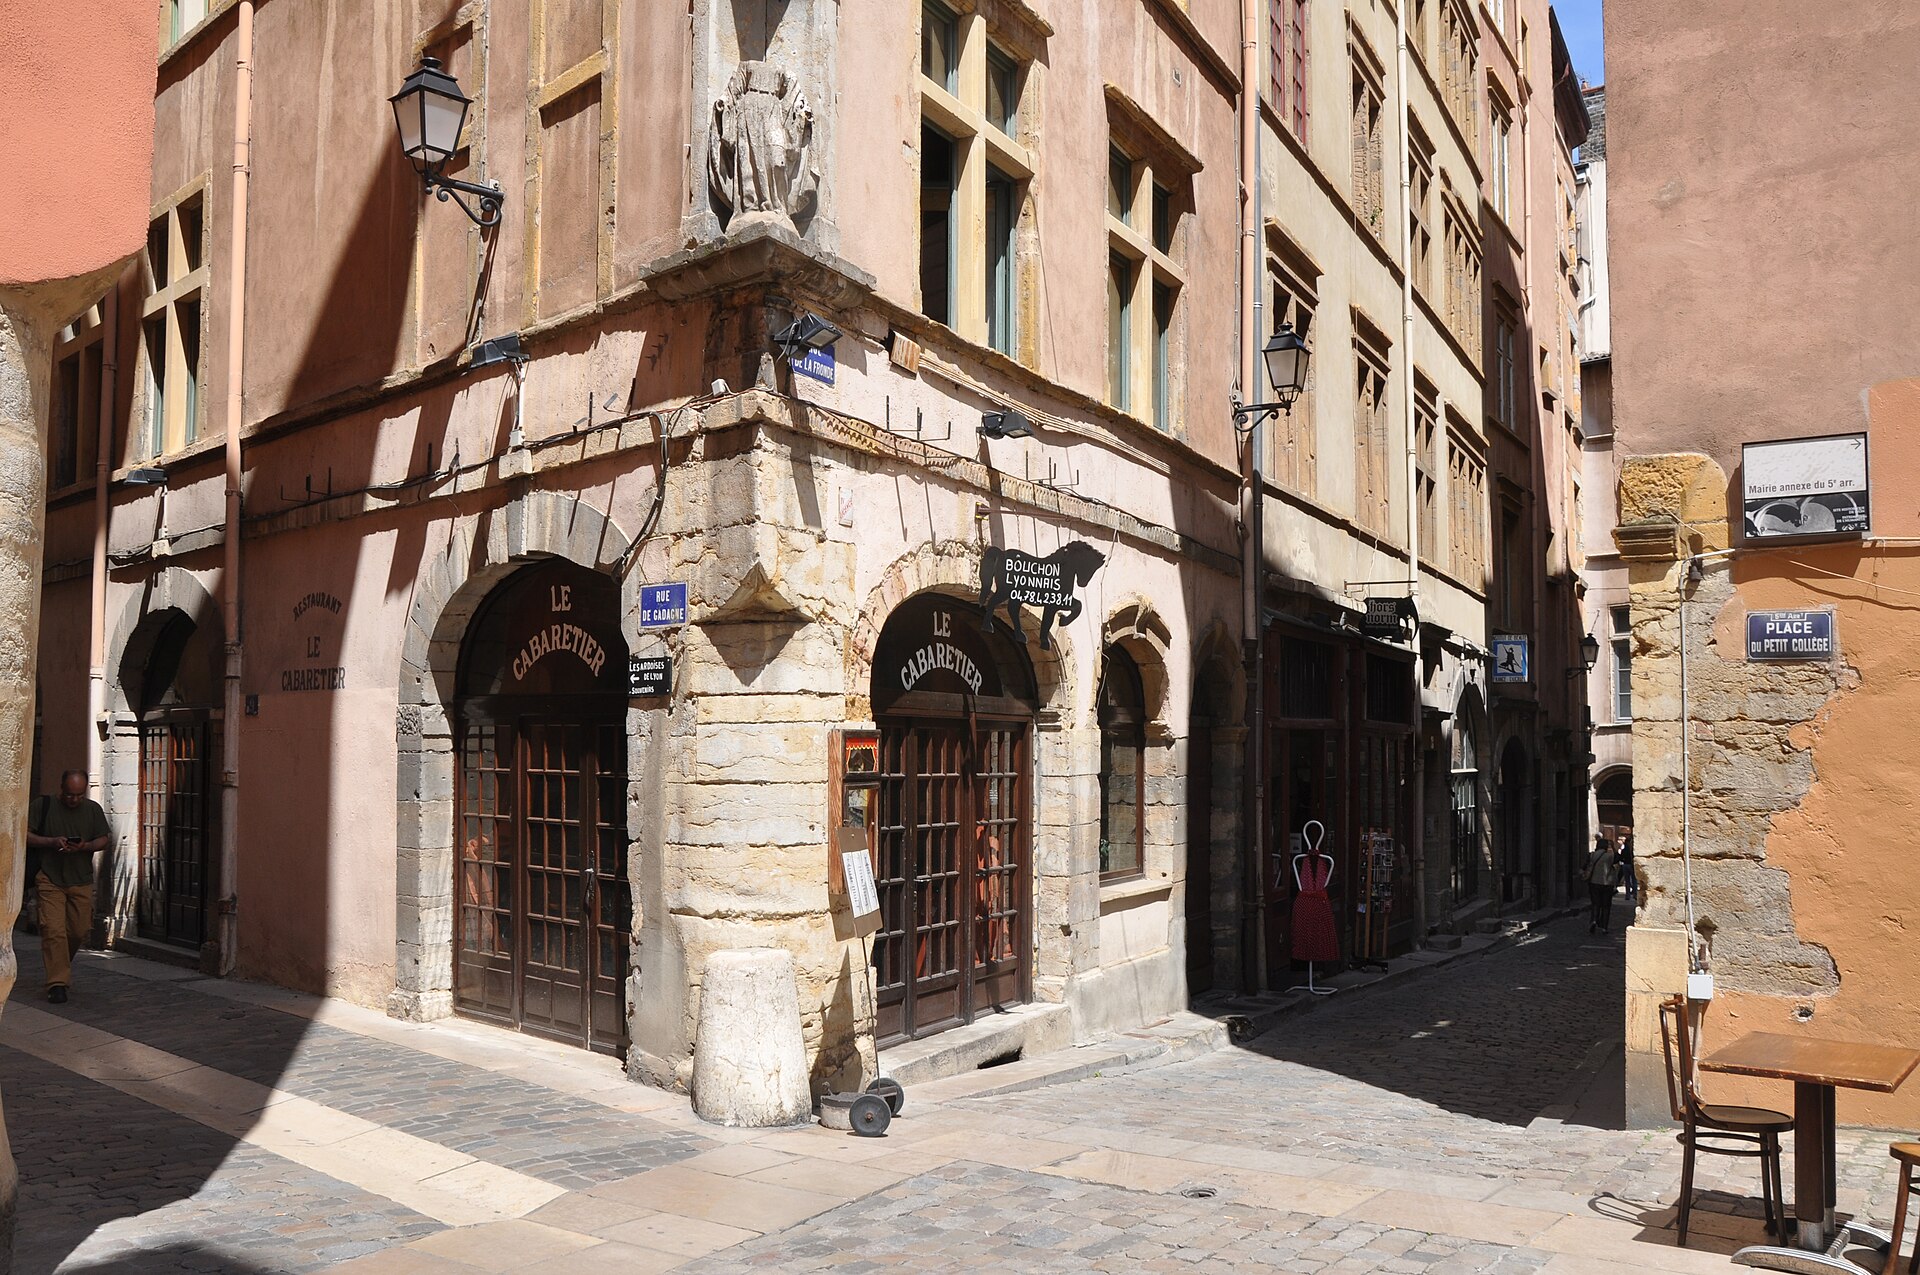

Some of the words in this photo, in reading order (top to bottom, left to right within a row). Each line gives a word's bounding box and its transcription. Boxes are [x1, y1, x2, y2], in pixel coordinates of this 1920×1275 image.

[804, 357, 812, 373] LA
[813, 361, 833, 380] FRONDE
[1748, 484, 1777, 494] Mairie
[1779, 482, 1812, 491] annexe
[1814, 480, 1825, 489] du
[1839, 479, 1855, 487] arr.
[1005, 559, 1060, 577] BOUCHON
[1005, 572, 1061, 591] LYONNAIS
[550, 585, 572, 612] LE
[655, 590, 670, 602] RUE
[292, 591, 343, 622] RESTAURANT
[642, 609, 651, 622] DE
[653, 607, 684, 621] GADAGNE
[1368, 599, 1397, 613] hors
[933, 610, 951, 638] LE
[1365, 612, 1399, 625] norm
[1766, 621, 1813, 634] PLACE
[307, 636, 321, 658] LE
[513, 623, 606, 681] CABARETIER
[1751, 641, 1762, 653] DU
[1764, 638, 1788, 652] PETIT
[1791, 636, 1829, 652] COLLÈGE
[281, 666, 346, 692] CABARETIER
[900, 642, 983, 697] CABARETIER
